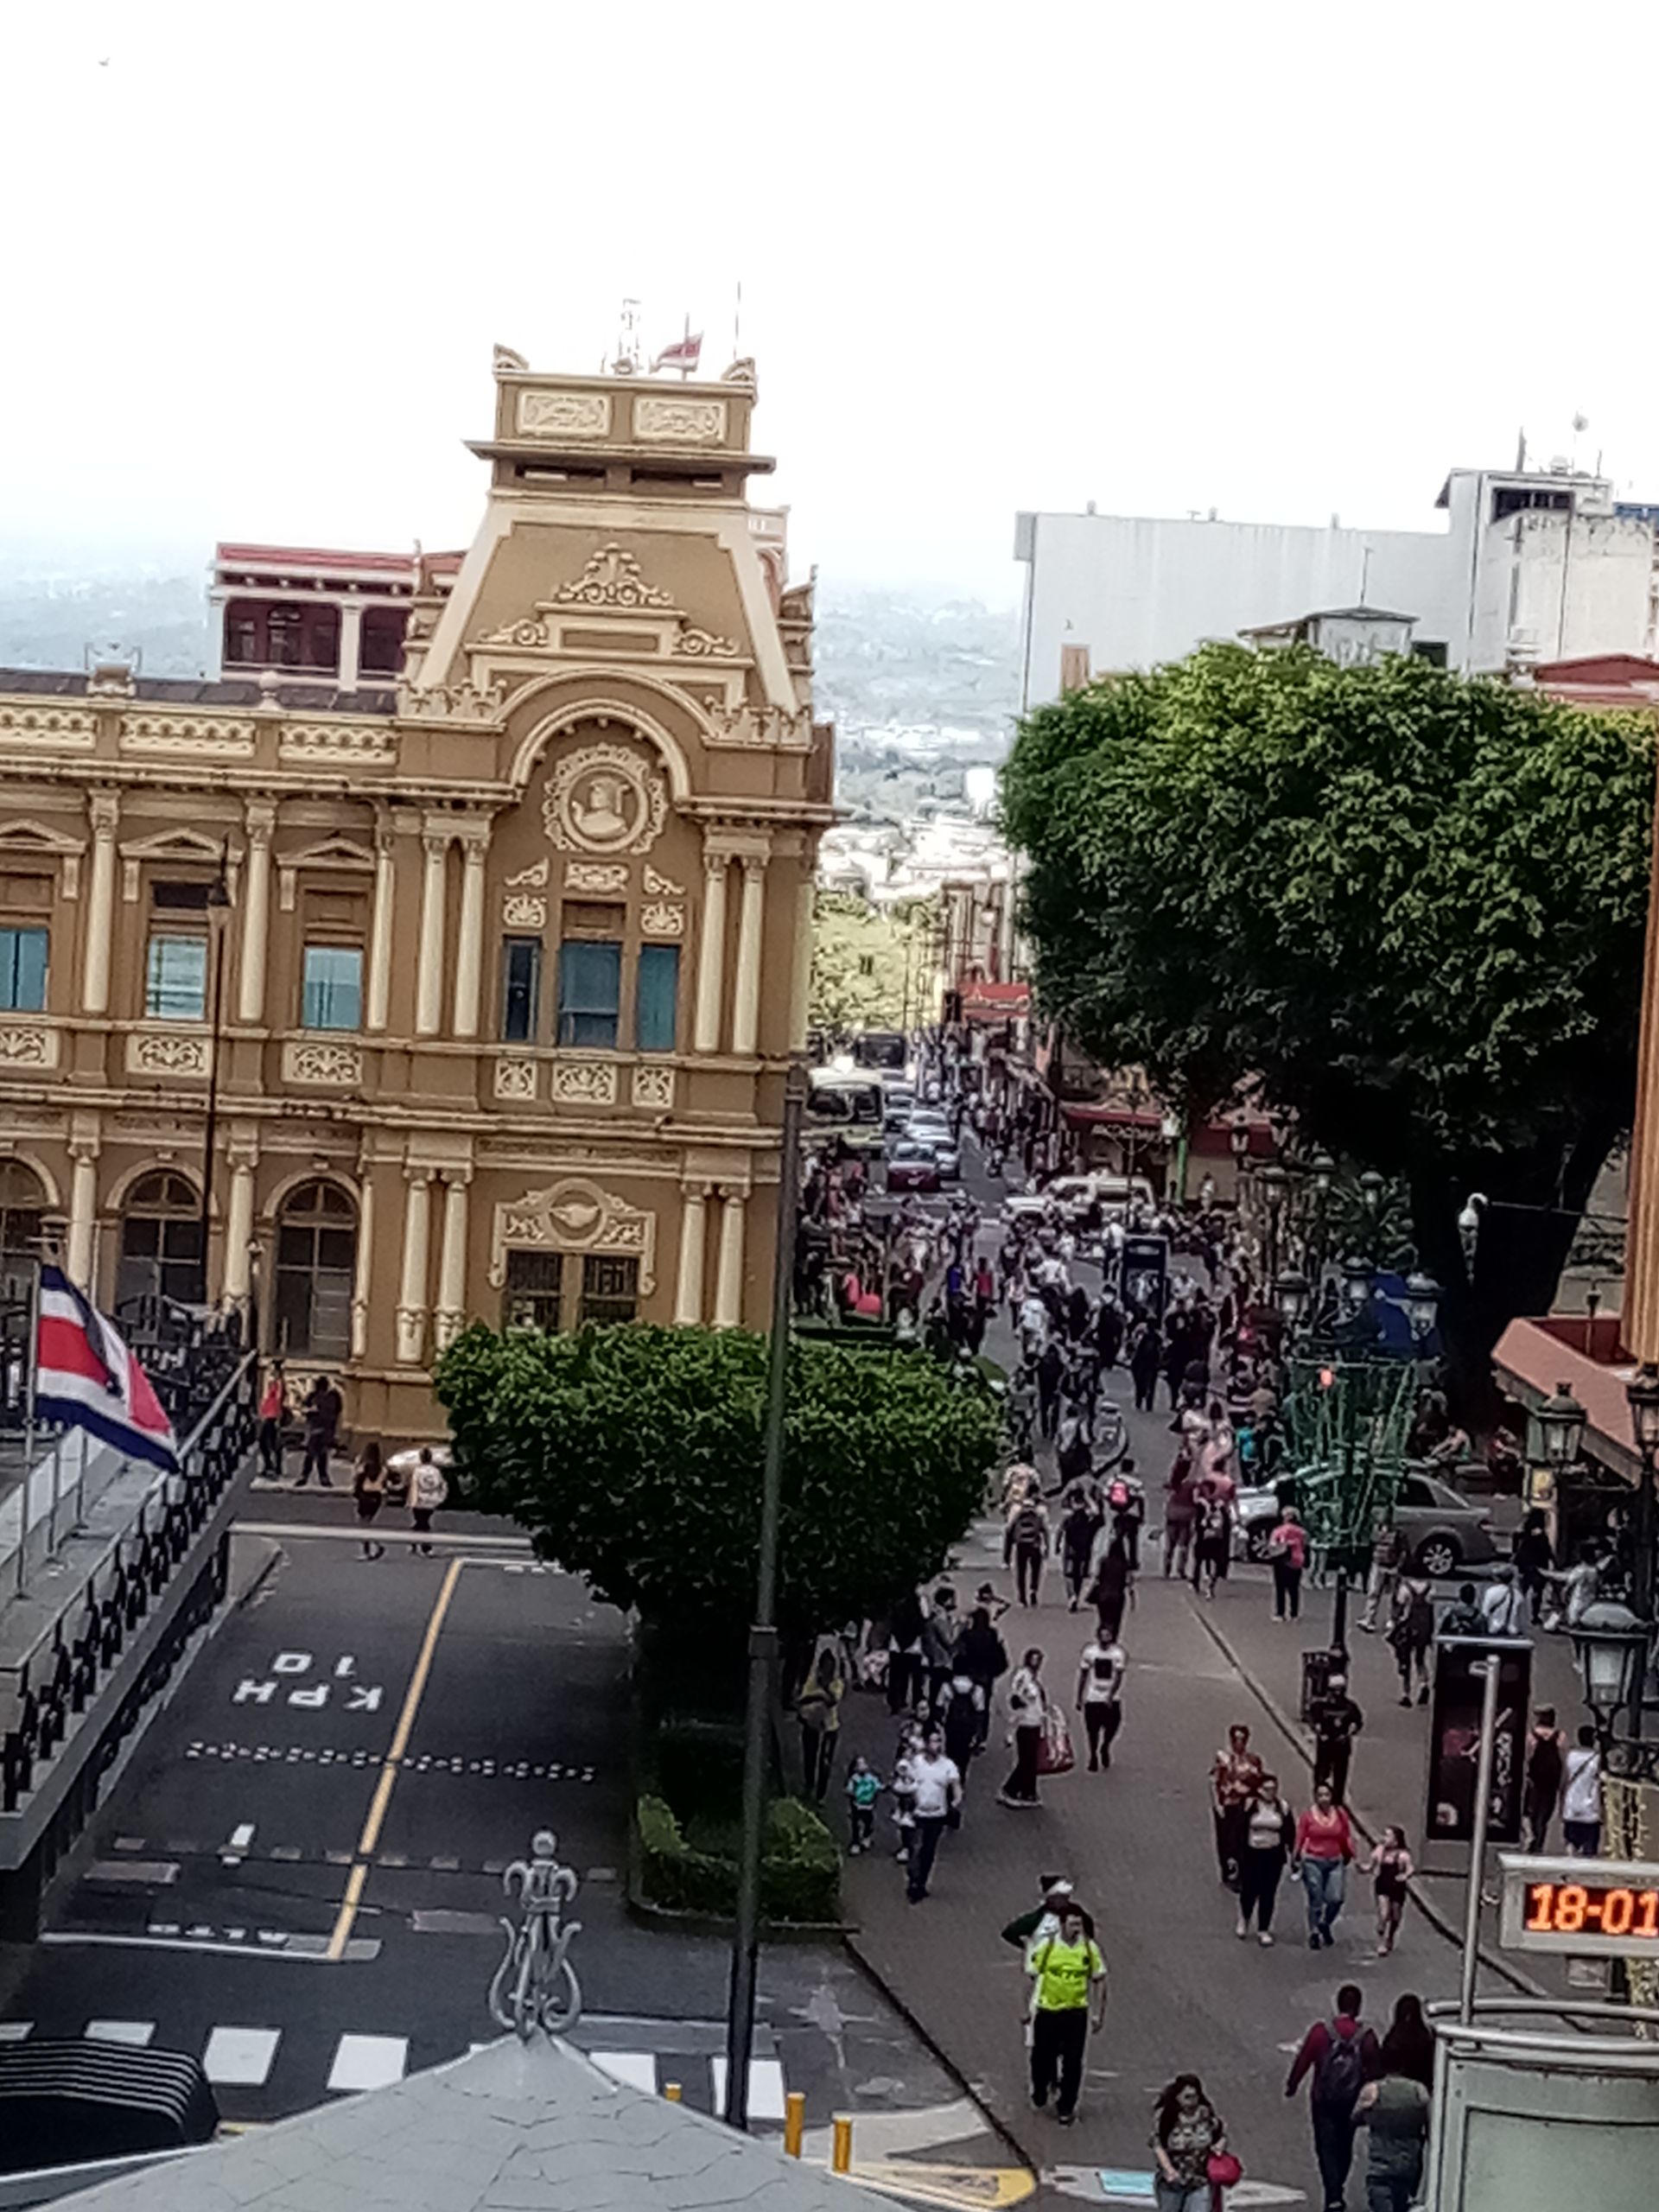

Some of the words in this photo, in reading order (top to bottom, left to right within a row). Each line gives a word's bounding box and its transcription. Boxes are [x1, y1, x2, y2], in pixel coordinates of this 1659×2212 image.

[273, 1653, 356, 1676] 10
[233, 1680, 382, 1710] KPH
[1526, 1884, 1658, 1937] 18-01
